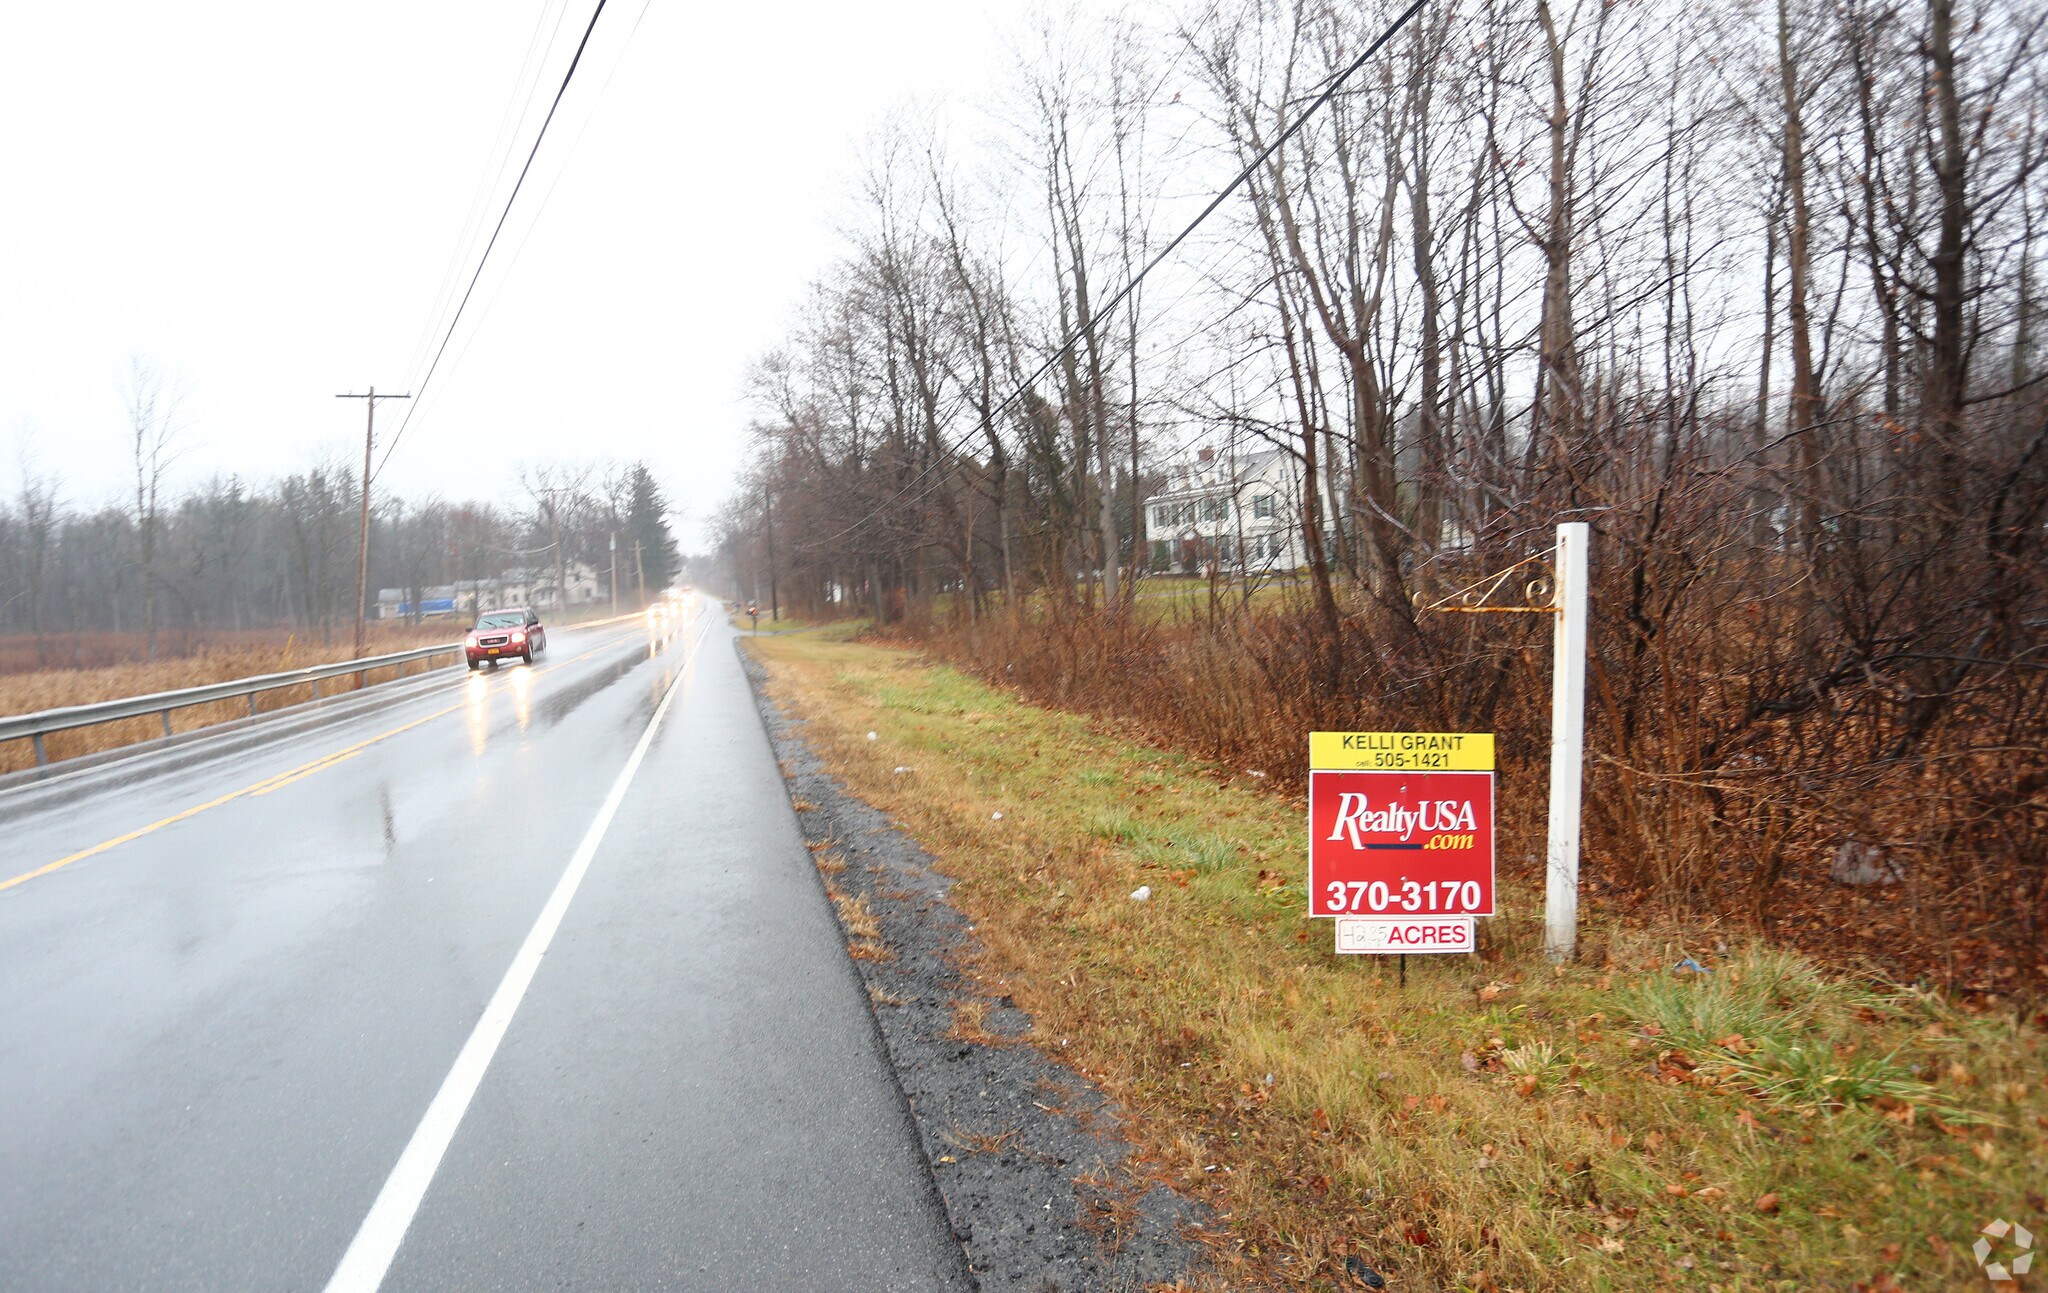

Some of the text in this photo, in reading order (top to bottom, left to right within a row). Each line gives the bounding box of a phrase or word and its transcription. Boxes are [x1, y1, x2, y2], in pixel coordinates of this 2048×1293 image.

[1342, 735, 1464, 750] KELLI GRANT
[1375, 752, 1449, 767] 505-1421
[1326, 792, 1477, 850] RealtyUSA
[1423, 834, 1475, 850] .com
[1326, 880, 1481, 911] 370-3170
[1387, 925, 1467, 944] ACRES
